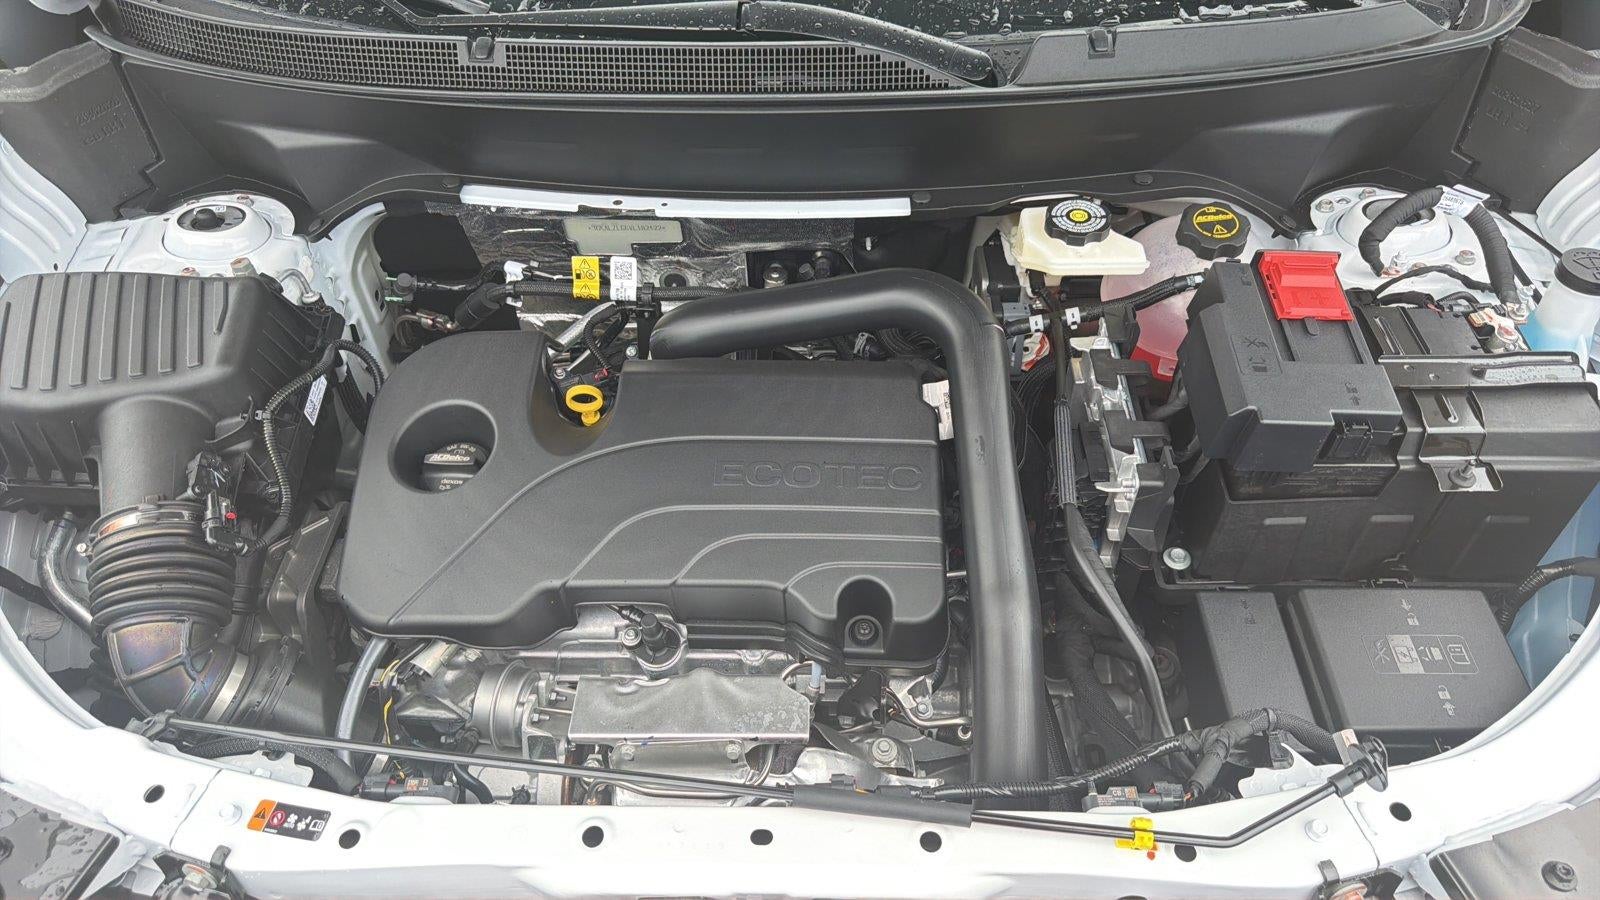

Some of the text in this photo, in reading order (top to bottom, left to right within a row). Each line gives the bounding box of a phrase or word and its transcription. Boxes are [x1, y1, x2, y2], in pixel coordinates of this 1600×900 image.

[1196, 213, 1233, 222] ACDelco
[429, 453, 471, 462] ACDelco
[713, 459, 923, 491] ECOTEC
